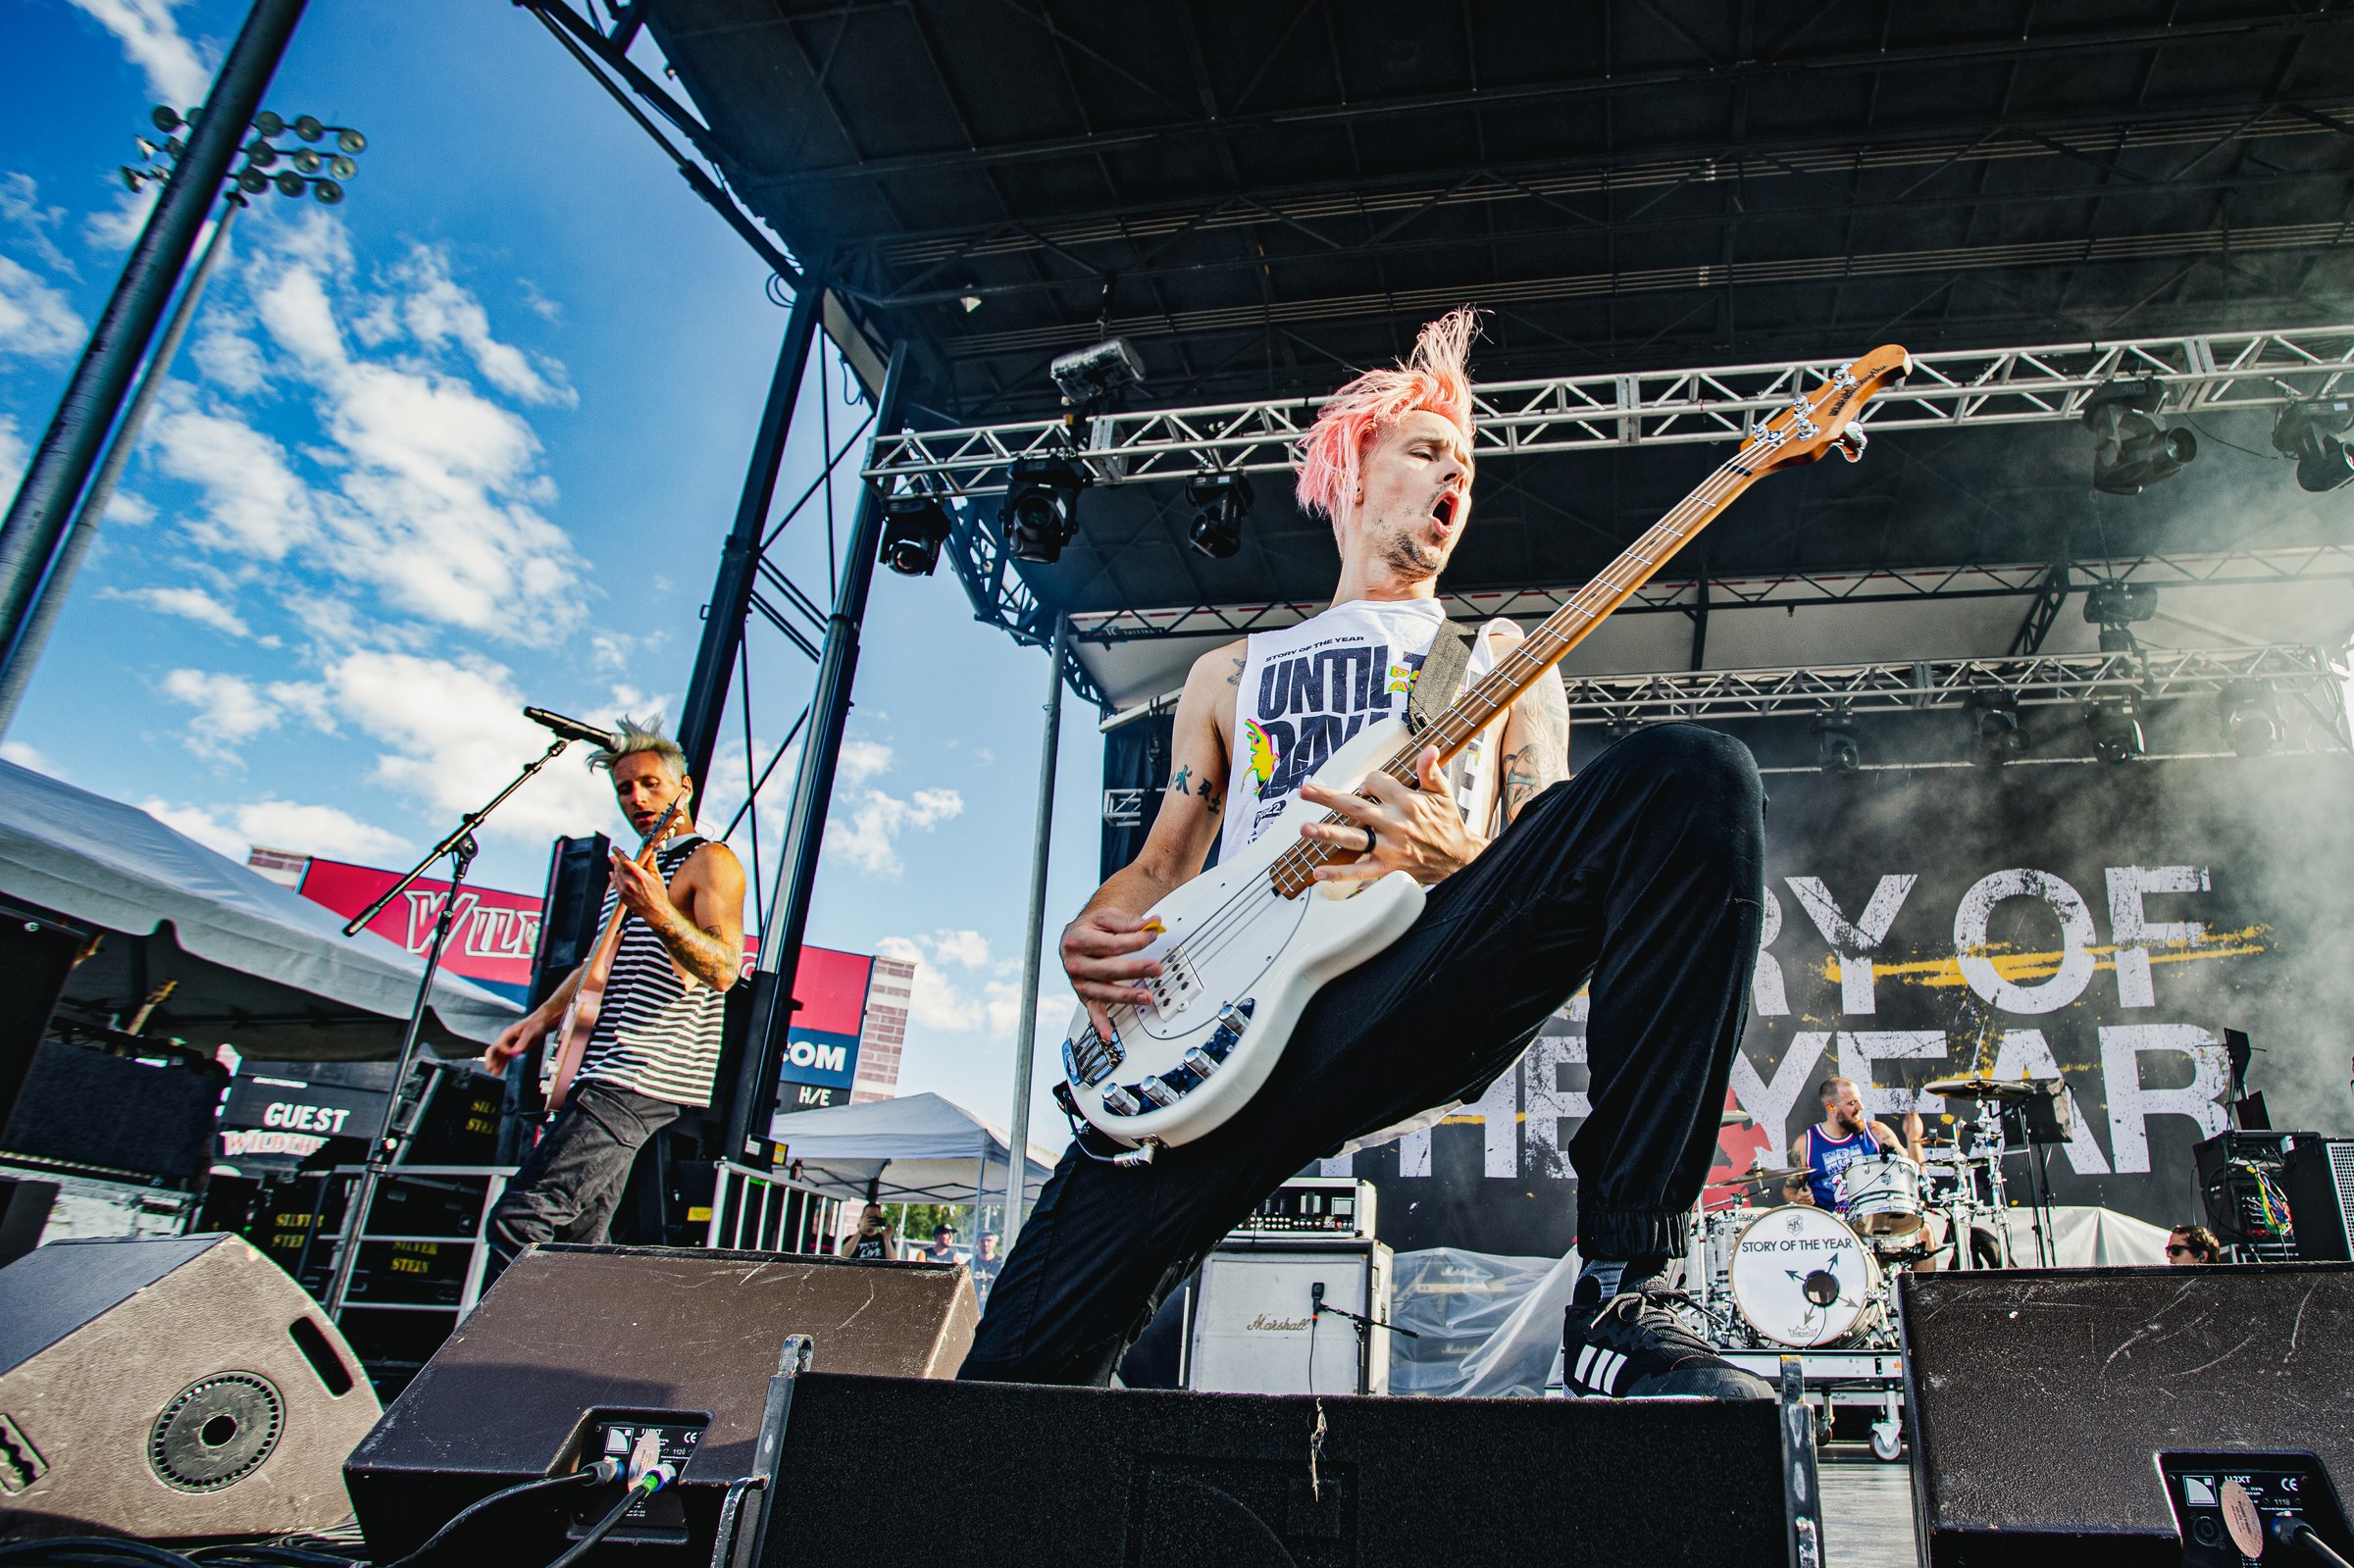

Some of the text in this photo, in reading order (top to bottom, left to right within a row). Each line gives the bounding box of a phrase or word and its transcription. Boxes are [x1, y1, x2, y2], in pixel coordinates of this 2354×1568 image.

[1265, 649, 1298, 663] STORY
[1299, 644, 1312, 654] OF
[1313, 638, 1333, 649] THE
[1257, 644, 1393, 721] UNTIL
[1954, 866, 2212, 1014] OF
[782, 1040, 846, 1073] OM
[798, 1086, 833, 1107] H/E
[263, 1101, 351, 1134] GUEST
[271, 1234, 306, 1248] STEI
[1742, 1238, 1853, 1252] STORY OF THE YEAR
[1247, 1313, 1311, 1331] Marshall
